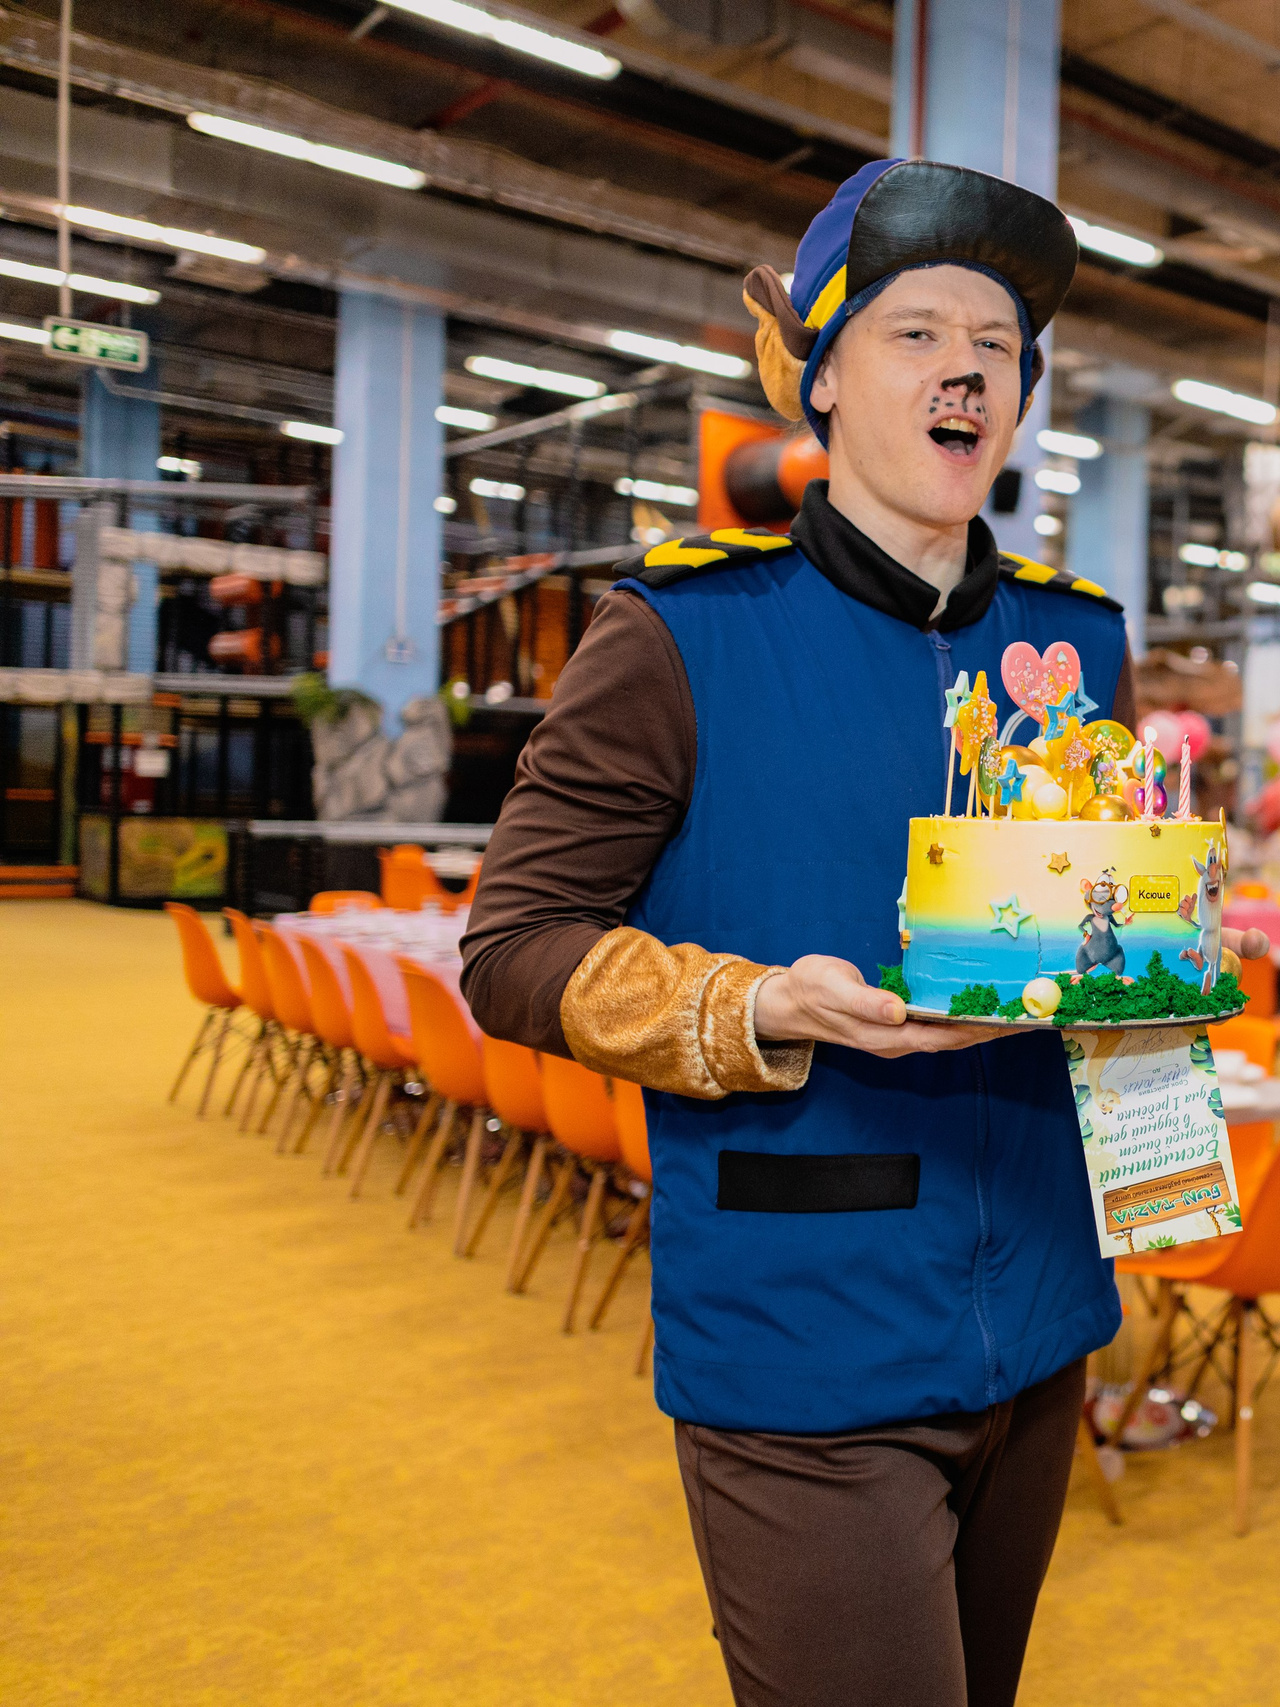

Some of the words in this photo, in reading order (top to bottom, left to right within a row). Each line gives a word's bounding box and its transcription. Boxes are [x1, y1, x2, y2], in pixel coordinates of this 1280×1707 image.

[1138, 889, 1171, 900] Ксюше
[1138, 1083, 1169, 1095] действия
[1171, 1079, 1188, 1089] Срок
[1185, 1084, 1206, 1102] для
[1116, 1095, 1168, 1121] ребёнка
[1173, 1096, 1179, 1111] 1
[1131, 1112, 1178, 1139] будний
[1183, 1113, 1190, 1128] в
[1098, 1124, 1126, 1145] день
[1165, 1123, 1217, 1147] входной
[1119, 1137, 1160, 1156] билет
[1098, 1139, 1218, 1187] Бесплатный
[1132, 1178, 1180, 1196] развлекательный
[1181, 1172, 1210, 1184] семейный
[1114, 1192, 1131, 1201] центр
